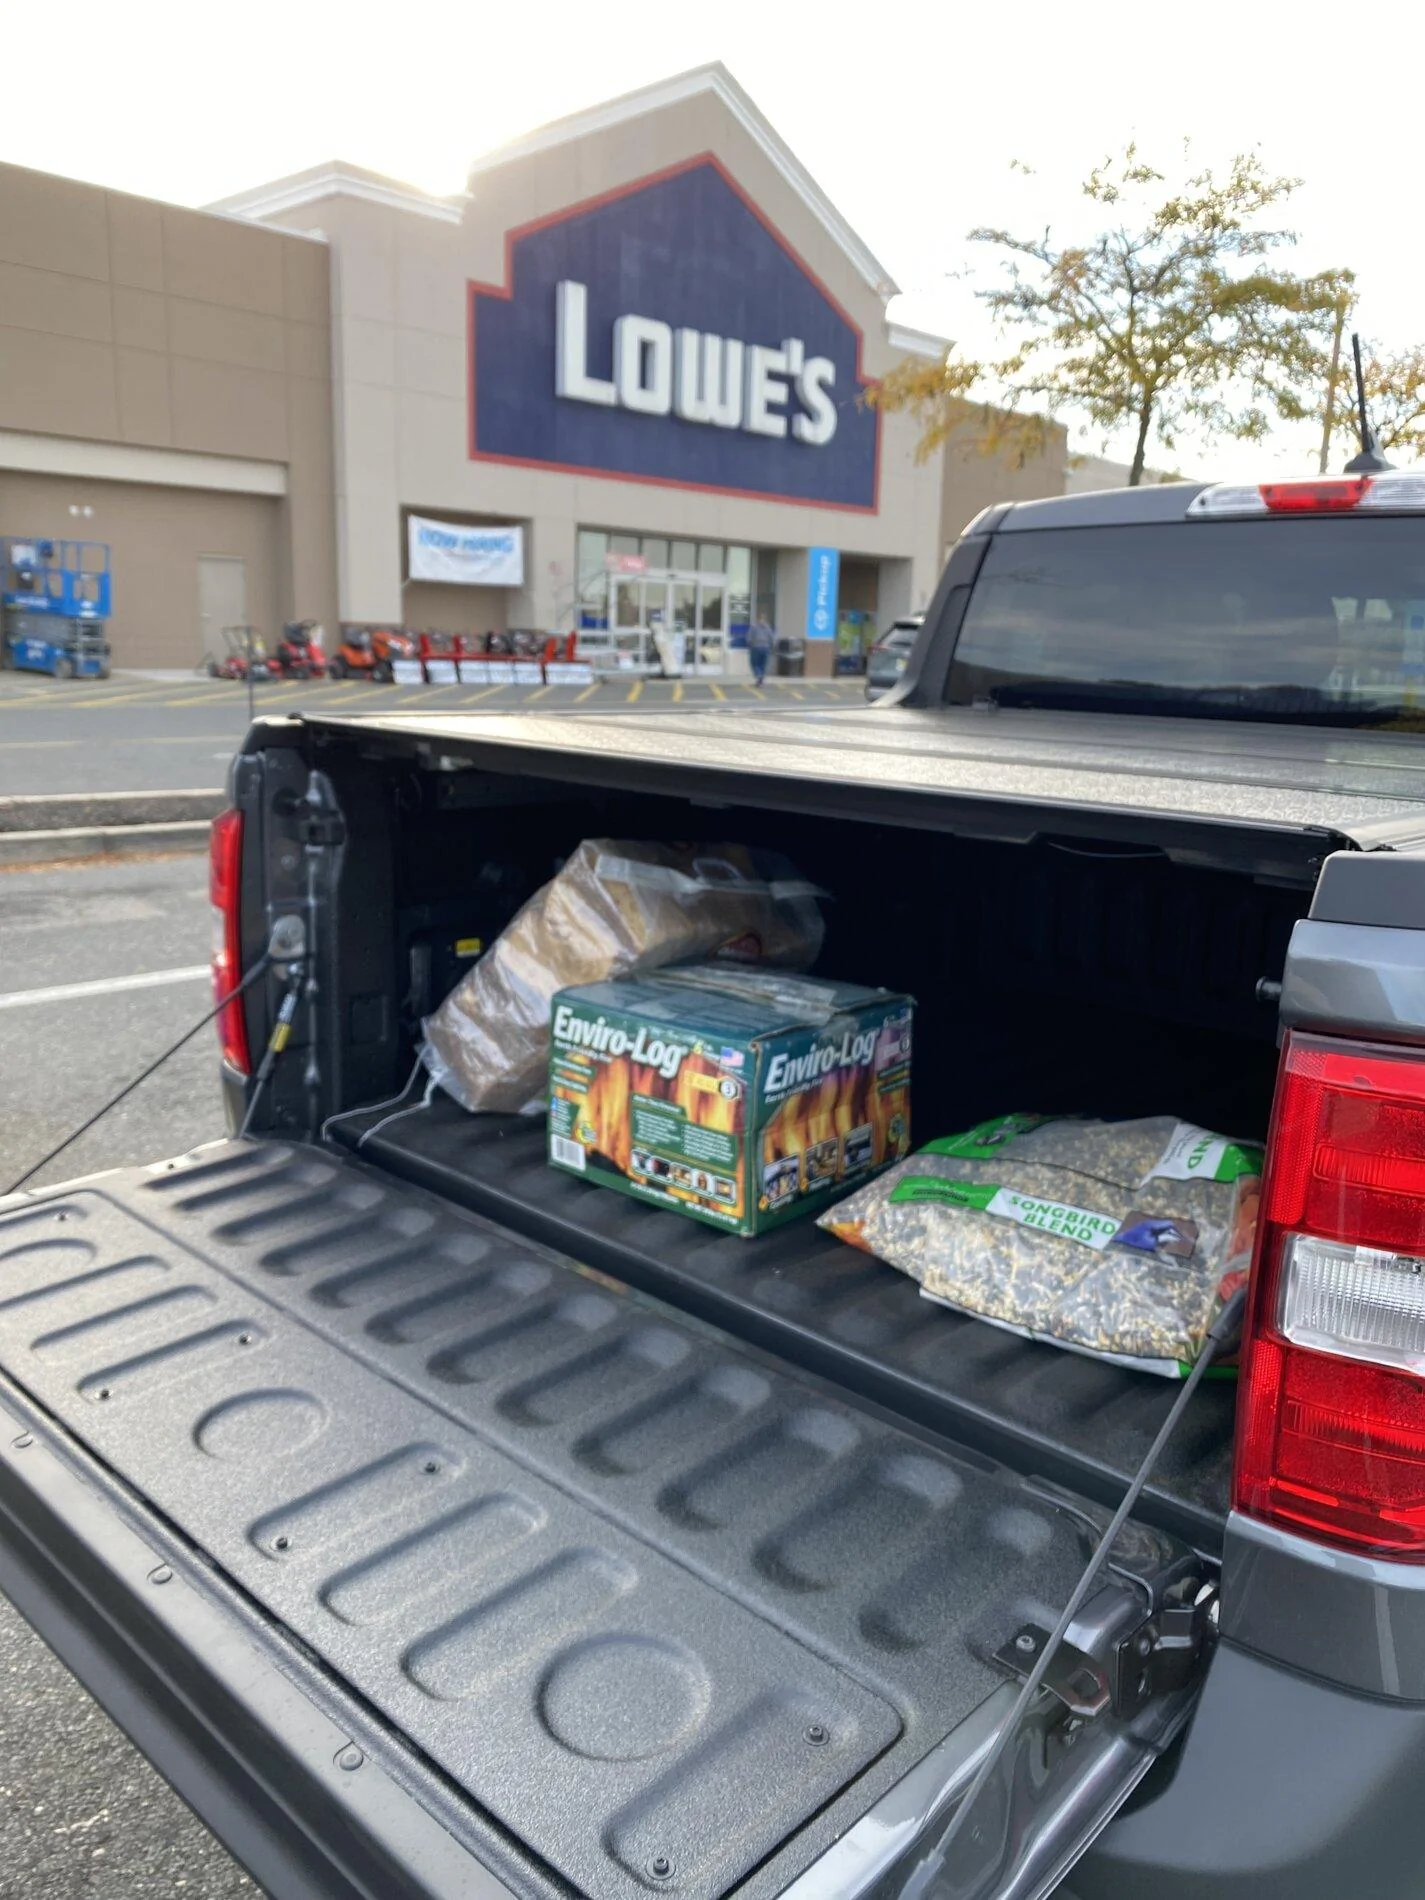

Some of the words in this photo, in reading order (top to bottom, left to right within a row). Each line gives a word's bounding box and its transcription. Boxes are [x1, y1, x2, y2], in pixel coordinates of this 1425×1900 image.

[553, 1004, 684, 1079] Enviro-Log
[763, 1029, 878, 1093] Enviro-Log
[1010, 1195, 1116, 1235] SONGBIRD
[1023, 1213, 1093, 1242] BLEND
